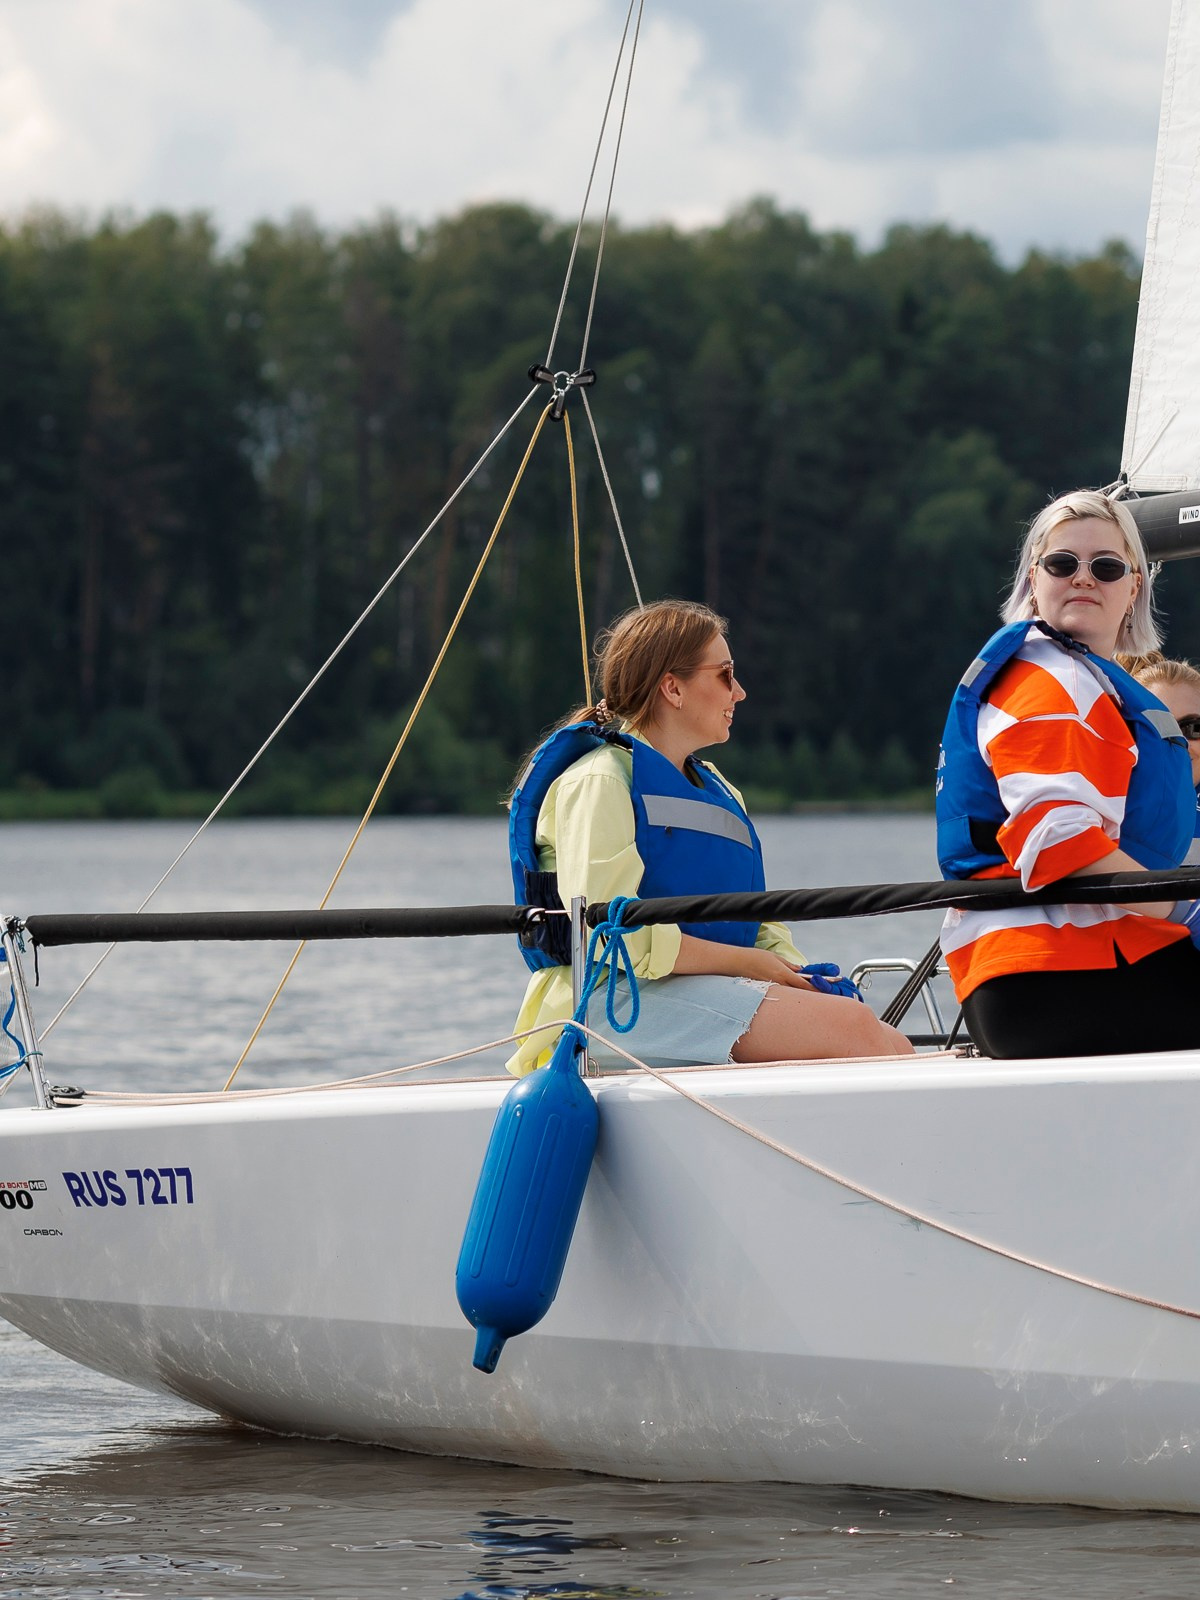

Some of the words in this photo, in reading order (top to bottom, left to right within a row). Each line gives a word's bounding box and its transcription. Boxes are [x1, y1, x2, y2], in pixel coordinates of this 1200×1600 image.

[1182, 509, 1199, 520] WIND
[61, 1169, 127, 1208] RUS
[124, 1166, 194, 1206] 7277
[23, 1228, 63, 1236] CARBON
